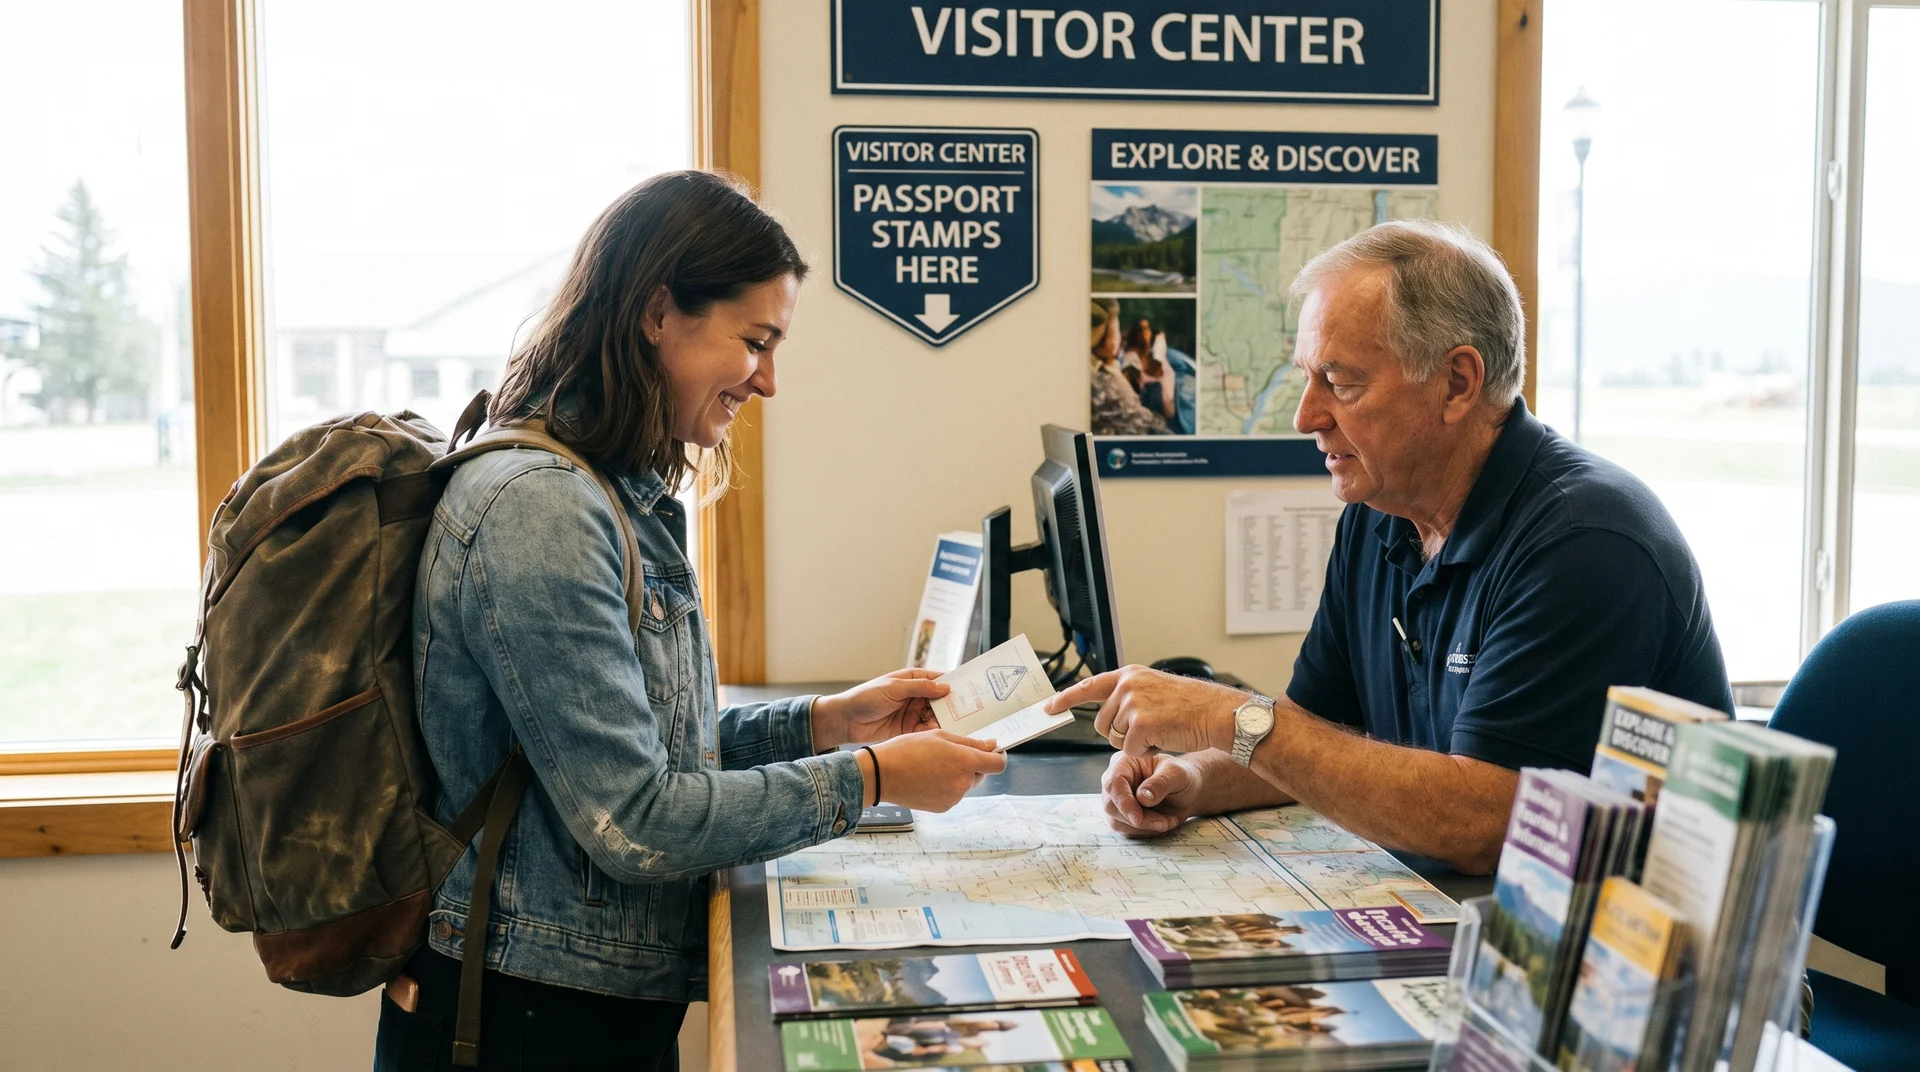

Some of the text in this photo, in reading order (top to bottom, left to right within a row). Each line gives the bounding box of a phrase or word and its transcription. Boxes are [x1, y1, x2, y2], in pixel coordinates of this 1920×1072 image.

[911, 6, 1365, 65] VISITOR CENTER
[846, 141, 1026, 164] VISITOR CENTER
[1111, 142, 1420, 173] EXPLORE & DISCOVER
[853, 184, 1021, 214] PASSPORT
[872, 219, 1001, 249] STAMPS
[896, 255, 979, 284] HERE
[1613, 708, 1666, 742] EXPLORE
[1611, 727, 1671, 766] DISCOVER
